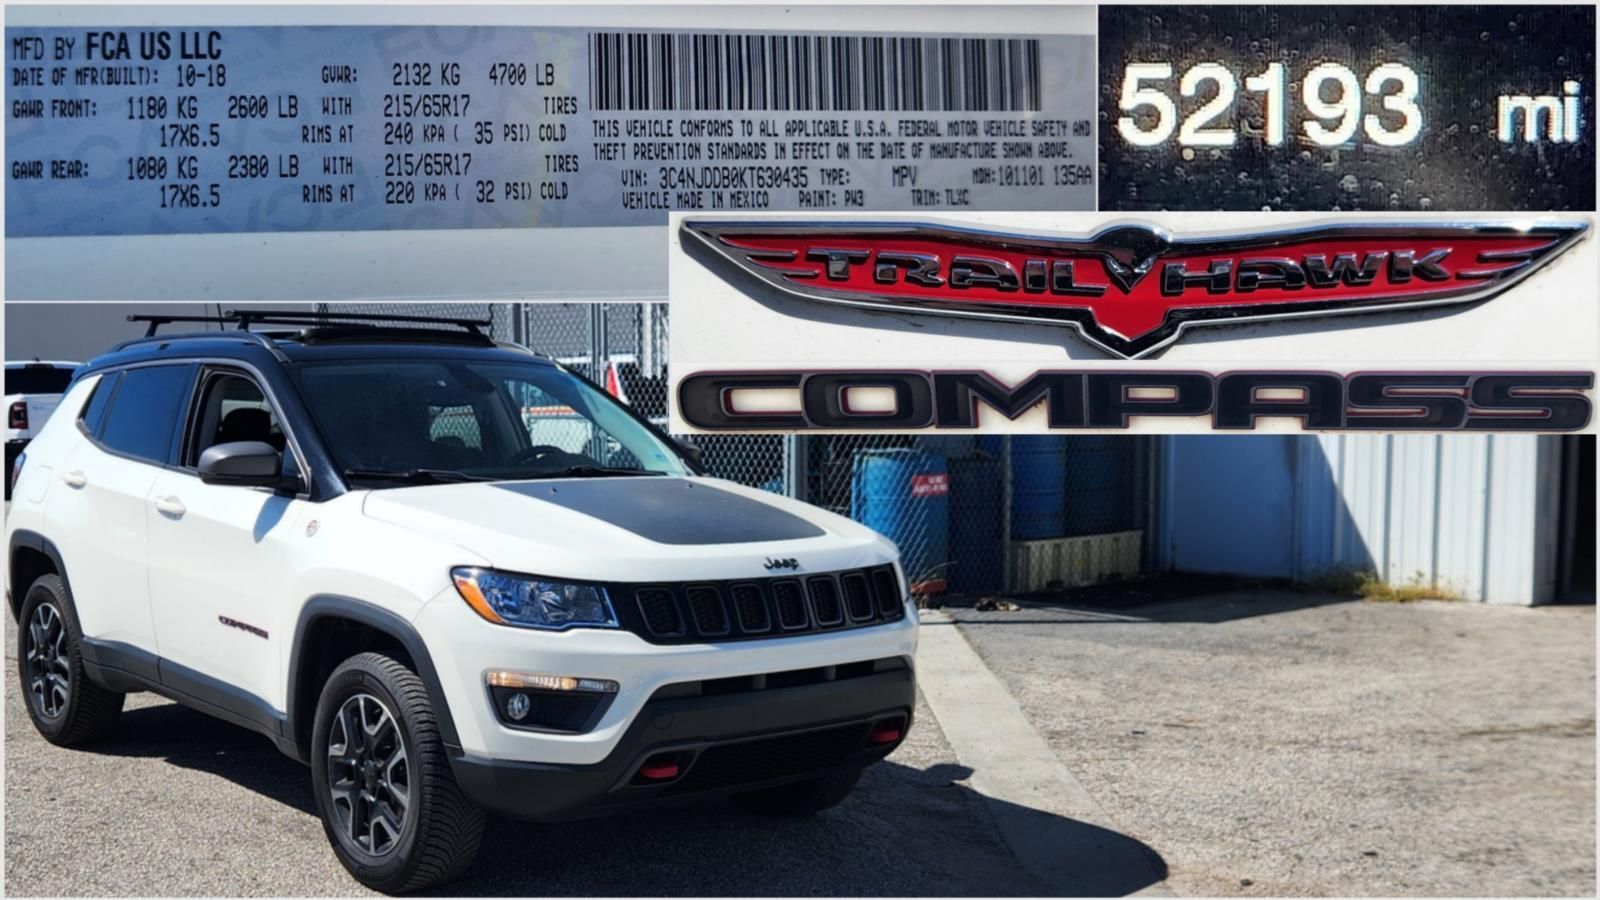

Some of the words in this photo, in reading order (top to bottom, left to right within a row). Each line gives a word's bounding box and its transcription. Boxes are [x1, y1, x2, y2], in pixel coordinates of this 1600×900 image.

[13, 37, 44, 60] MFD
[54, 37, 75, 60] BY
[86, 31, 131, 60] FCA
[140, 31, 171, 60] US
[180, 31, 222, 60] LLC
[13, 67, 44, 86] DATE
[52, 67, 67, 86] OF
[75, 66, 159, 86] MFR(BUILT):
[177, 64, 226, 87] 10-18
[322, 65, 358, 84] GVWR:
[392, 63, 431, 86] 2132
[441, 63, 460, 86] KG
[489, 63, 527, 86] 4700
[536, 63, 554, 86] LB
[12, 99, 44, 119] GAWR
[51, 99, 97, 119] FRONT:
[127, 96, 167, 120] 1180
[177, 96, 198, 119] KG
[228, 95, 268, 119] 2600
[278, 95, 298, 118] LB
[322, 97, 352, 115] WITH
[384, 94, 471, 118] 215/65R17
[543, 96, 578, 115] TIRES
[1116, 61, 1423, 148] 52193
[1497, 79, 1581, 144] mi
[160, 123, 220, 148] 17X6.5
[302, 124, 332, 144] RIMS
[339, 124, 354, 143] AT
[384, 122, 413, 145] 240
[423, 124, 445, 143] KPA
[474, 122, 493, 144] 35
[503, 123, 530, 143] PSI)
[539, 123, 567, 142] COLD
[592, 119, 619, 137] THIS
[626, 119, 673, 137] VEHICLE
[680, 119, 733, 137] CONFORMS
[741, 120, 753, 137] TO
[759, 120, 779, 137] ALL
[785, 120, 848, 137] APPLICABLE
[854, 120, 892, 137] U.S.A.
[898, 120, 942, 137] FEDERAL
[947, 120, 978, 137] MOTOR
[983, 120, 1025, 137] VEHICLE
[1031, 120, 1067, 137] SAFETY
[1072, 120, 1091, 137] AND
[593, 142, 626, 160] THEFT
[633, 142, 700, 160] PREVENTION
[708, 142, 767, 160] STANDARDS
[774, 142, 786, 160] IN
[792, 142, 830, 160] EFFECT
[836, 142, 850, 160] ON
[856, 142, 874, 159] THE
[880, 142, 905, 159] DATE
[911, 142, 923, 159] OF
[929, 142, 997, 159] MANUFACTURE
[1002, 142, 1033, 158] SHOWN
[1038, 142, 1073, 158] ABOVE.
[12, 160, 44, 180] GAWR
[51, 160, 89, 179] REAR:
[127, 156, 167, 180] 1080
[177, 156, 198, 180] KG
[228, 155, 268, 179] 2380
[279, 155, 299, 178] LB
[323, 156, 353, 175] WITH
[385, 153, 472, 177] 215/65R17
[545, 154, 579, 173] TIRES
[621, 169, 648, 188] VIN:
[659, 166, 809, 190] 3C4NJDDB0KT630435
[820, 168, 850, 186] TYPE:
[892, 165, 918, 187] MPV
[1053, 165, 1093, 187] 135AA
[160, 184, 221, 208] 17X6.5
[303, 184, 333, 203] RIMS
[340, 184, 355, 203] AT
[385, 181, 415, 204] 220
[425, 183, 446, 202] KPA
[476, 180, 495, 203] 32
[505, 182, 532, 201] PSI)
[540, 182, 568, 200] COLD
[622, 190, 670, 209] VEHICLE
[676, 190, 703, 209] MADE
[712, 190, 723, 208] IN
[729, 190, 769, 208] MEXICO
[798, 190, 837, 207] PAINT:
[844, 190, 864, 207] PW3
[676, 369, 1593, 432] COMPASS
[763, 556, 799, 571] Jeep
